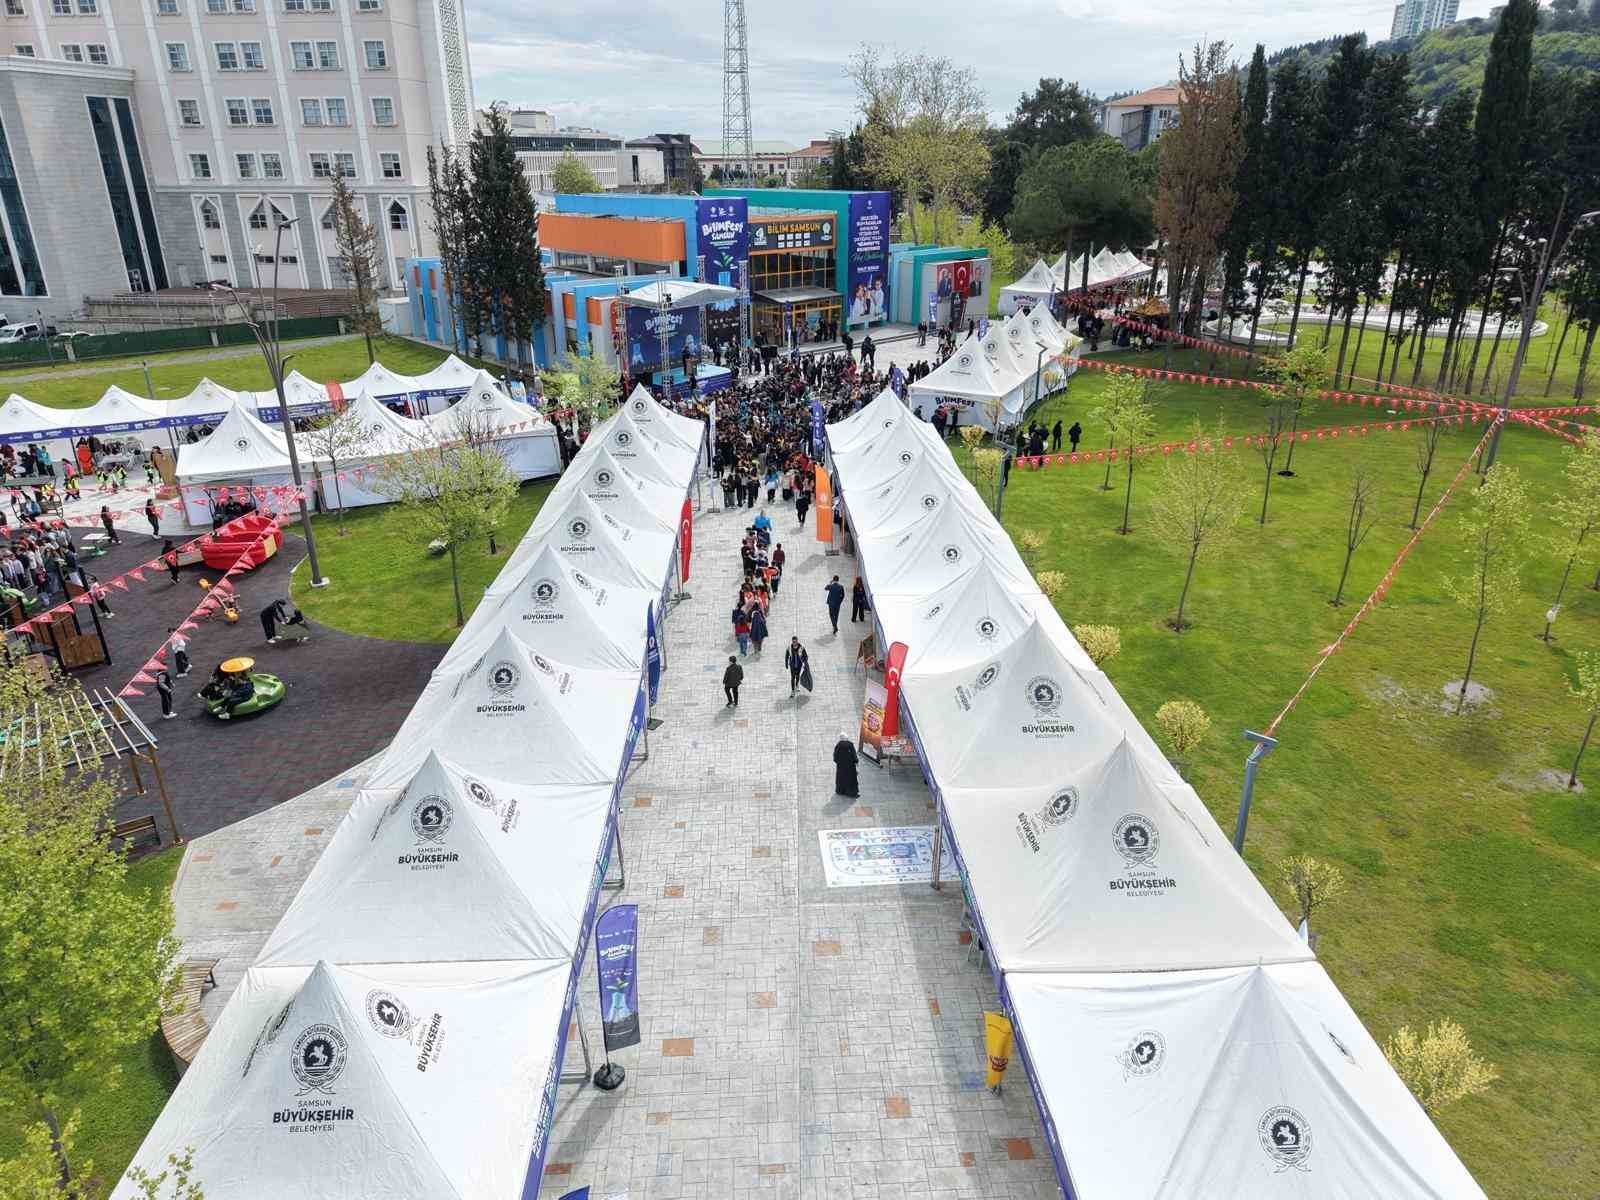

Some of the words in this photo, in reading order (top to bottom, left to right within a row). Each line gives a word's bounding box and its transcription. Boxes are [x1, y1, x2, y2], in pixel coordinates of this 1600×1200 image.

[476, 704, 526, 713] BÜYÜKŞEHİR
[1022, 723, 1075, 734] BÜYÜKŞEHİR
[398, 852, 460, 865] BÜYÜKŞEHİR
[1109, 877, 1177, 890] BÜYÜKŞEHİR
[416, 1012, 443, 1073] BÜYÜKŞEHİR
[297, 1099, 332, 1108] SAMSUN
[272, 1108, 355, 1124] BÜYÜKŞEHİR
[289, 1124, 335, 1134] BELEDİYESİ
